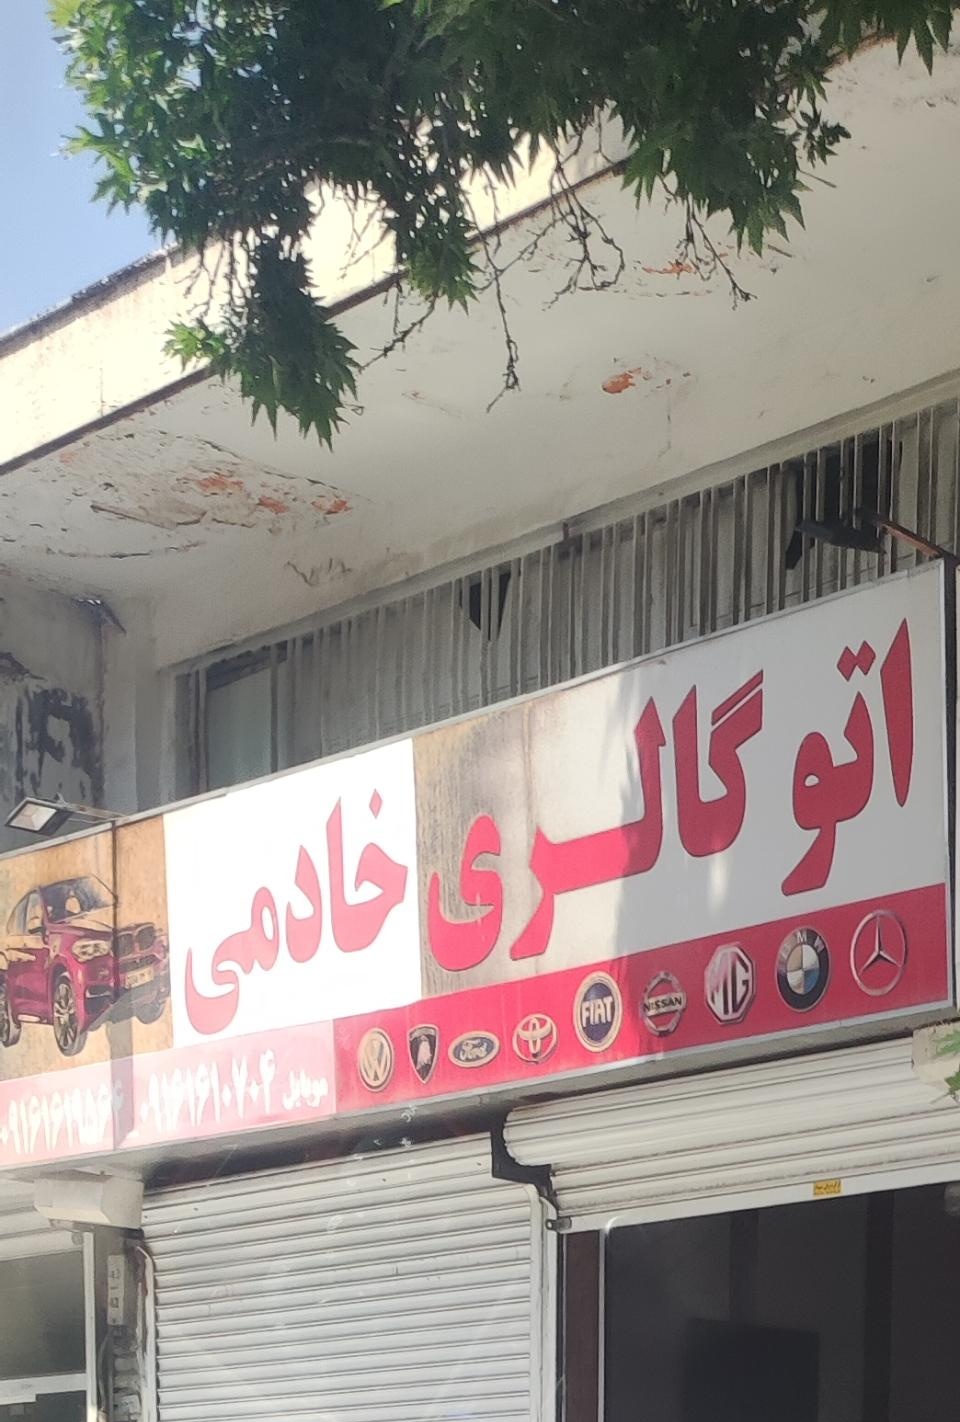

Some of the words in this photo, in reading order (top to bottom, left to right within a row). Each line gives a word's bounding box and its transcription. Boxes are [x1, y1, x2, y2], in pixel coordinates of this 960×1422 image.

[782, 618, 913, 895] اتو
[427, 669, 764, 971] گالری
[185, 788, 408, 1035] خادمی
[581, 998, 614, 1027] FIAT
[643, 996, 682, 1011] NISSAN
[708, 949, 751, 1018] MG
[283, 1070, 329, 1110] موبایل
